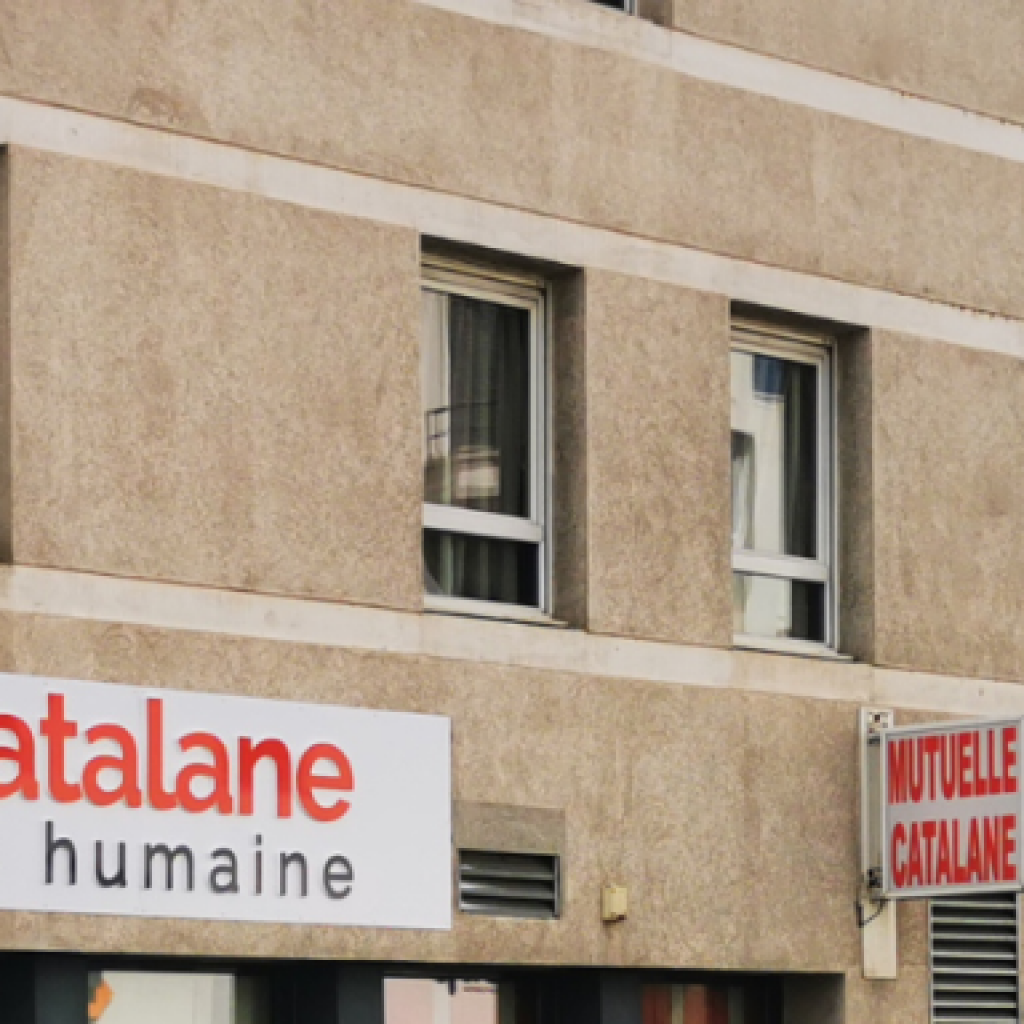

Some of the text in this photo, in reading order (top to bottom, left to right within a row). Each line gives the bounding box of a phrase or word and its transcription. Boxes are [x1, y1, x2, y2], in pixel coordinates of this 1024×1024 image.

[887, 727, 1018, 804] MUTUELLE
[44, 820, 355, 900] humaine
[890, 814, 1017, 889] CATALANE
